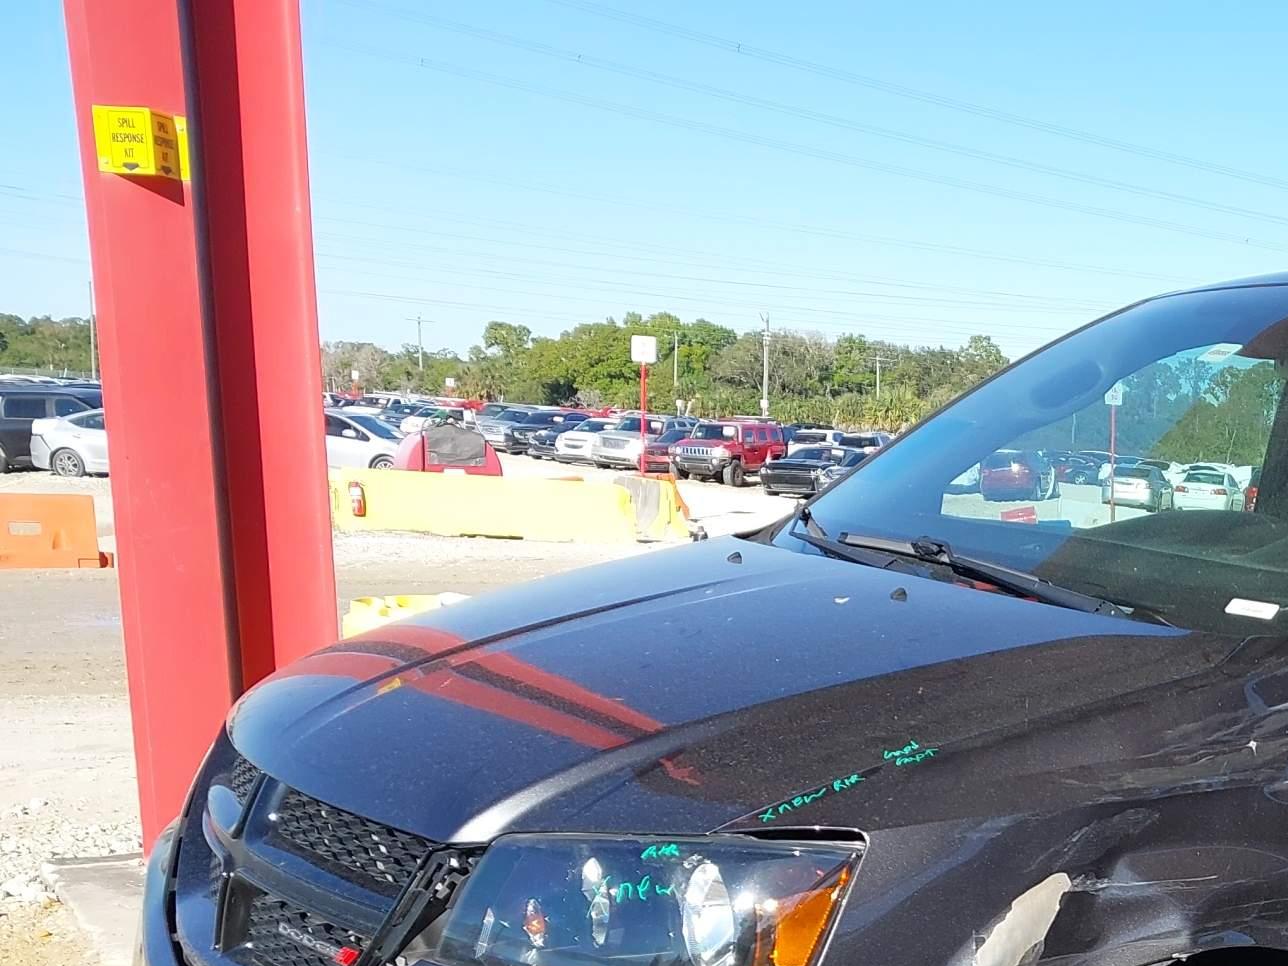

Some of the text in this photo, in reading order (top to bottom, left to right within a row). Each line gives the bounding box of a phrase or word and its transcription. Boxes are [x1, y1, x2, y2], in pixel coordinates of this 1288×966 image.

[117, 117, 135, 128] SPILL
[111, 133, 145, 143] RESPONSE
[124, 148, 135, 158] KIT
